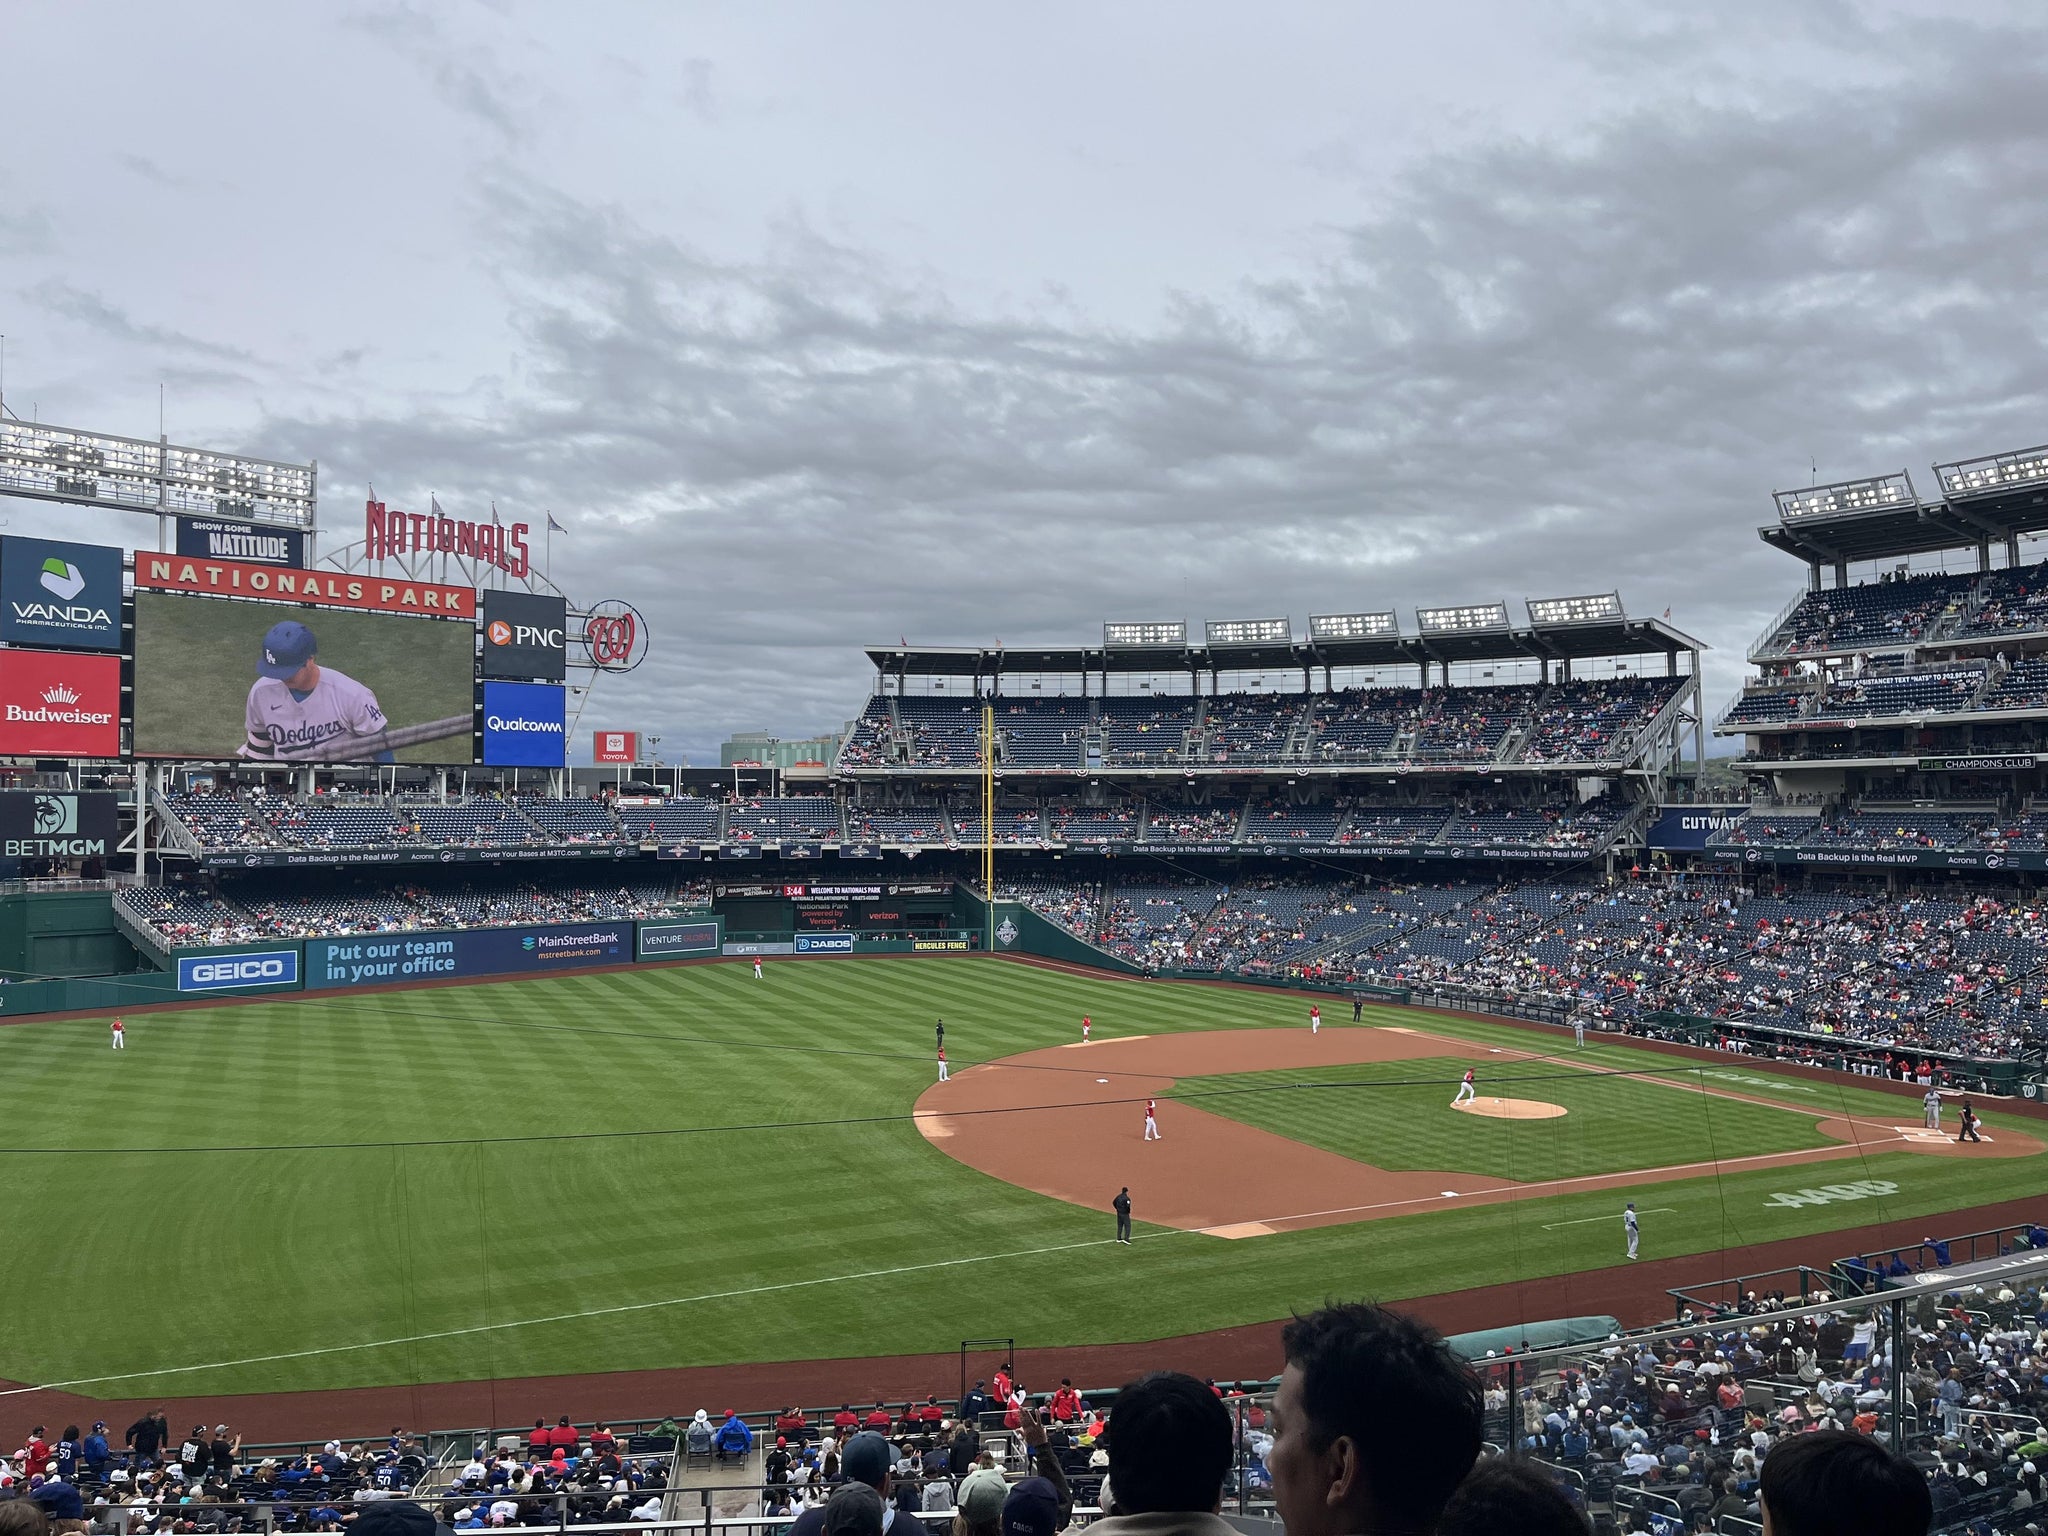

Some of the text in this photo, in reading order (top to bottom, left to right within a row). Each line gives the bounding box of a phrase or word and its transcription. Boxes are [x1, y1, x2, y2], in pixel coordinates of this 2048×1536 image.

[192, 521, 252, 534] SHOW SOME
[366, 500, 528, 578] NATIONALS
[209, 532, 289, 559] NATITUDE
[151, 560, 461, 610] NATIONALS PARK
[12, 601, 112, 625] VANDA
[16, 618, 93, 630] PHARMACEUTICALS
[514, 625, 564, 648] PNC
[1854, 678, 1894, 687] ASSISTANCE?
[6, 704, 112, 724] Budweiser
[487, 715, 562, 732] Qualcomm
[266, 720, 347, 748] Dodgers
[1945, 760, 2003, 769] CHAMPIONS
[2005, 759, 2032, 767] CLUB
[1682, 816, 1748, 830] CUTWAT
[5, 839, 105, 857] BETMGM
[1133, 845, 1149, 853] Data
[1150, 845, 1176, 854] Backup
[1186, 845, 1196, 853] the
[1197, 845, 1213, 853] Real
[1214, 845, 1230, 853] MVP
[1299, 846, 1321, 854] Cover
[1339, 847, 1362, 855] Bases
[288, 855, 308, 863] Data
[308, 854, 338, 864] Backup
[349, 854, 362, 862] the
[362, 853, 380, 862] Real
[381, 853, 399, 861] MVP
[411, 853, 435, 861] Acronis
[480, 851, 501, 859] Cover
[519, 850, 539, 858] Bases
[547, 849, 581, 857] M3TC.com
[1483, 849, 1500, 857] Data
[1501, 850, 1530, 858] Backup
[1539, 850, 1551, 858] the
[1571, 851, 1589, 859] MVP
[1714, 851, 1739, 859] Acronis
[1797, 852, 1816, 861] Data
[1817, 853, 1850, 863] Backup
[1861, 854, 1875, 862] the
[1877, 854, 1896, 863] Real
[1898, 855, 1918, 863] MVP
[209, 857, 237, 865] Acronis
[786, 887, 802, 895] 3:44
[832, 902, 849, 910] Park
[802, 910, 843, 919] powered by
[869, 912, 899, 920] verizon
[538, 931, 618, 948] MainStreetBank
[645, 934, 682, 945] VENTURE
[811, 940, 851, 948] DABOS
[327, 940, 454, 961] Put our team
[915, 942, 946, 950] HERCULES
[538, 948, 601, 960] mstreetbank.com
[192, 959, 283, 983] GEICO
[327, 956, 455, 983] in your office
[60, 1448, 71, 1460] 50
[377, 1475, 391, 1486] 50
[1012, 1521, 1034, 1533] COACH
